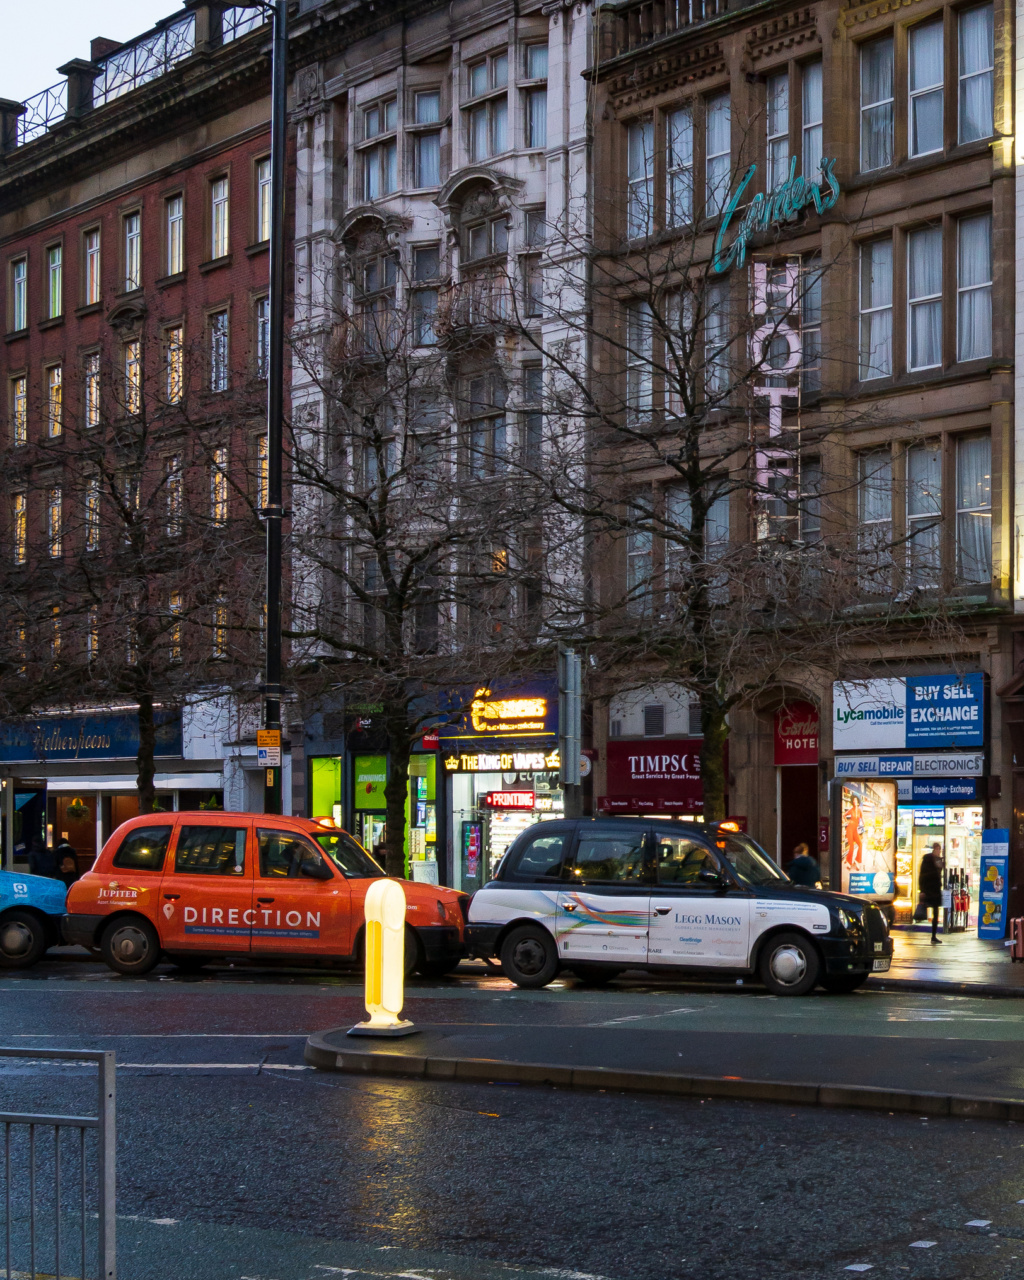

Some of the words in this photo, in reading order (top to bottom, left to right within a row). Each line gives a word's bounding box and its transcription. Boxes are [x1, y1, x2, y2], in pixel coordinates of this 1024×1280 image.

[915, 685, 940, 701] BUY
[943, 684, 974, 700] SELL
[837, 706, 904, 724] Lycamobile
[910, 705, 979, 723] EXCHANGE
[786, 738, 819, 749] HOTE
[460, 754, 478, 770] THE
[478, 753, 501, 770] KING
[500, 753, 513, 770] OF
[513, 752, 545, 770] VAPES
[837, 762, 856, 773] BUY
[858, 762, 877, 772] SELL
[880, 761, 913, 772] REPAIR
[915, 759, 980, 771] ELECTRONICS
[492, 793, 534, 806] PRINTING
[97, 887, 138, 899] JUPITER
[184, 906, 321, 928] DIRECTION
[675, 913, 702, 924] LEGG
[704, 914, 742, 926] MASON
